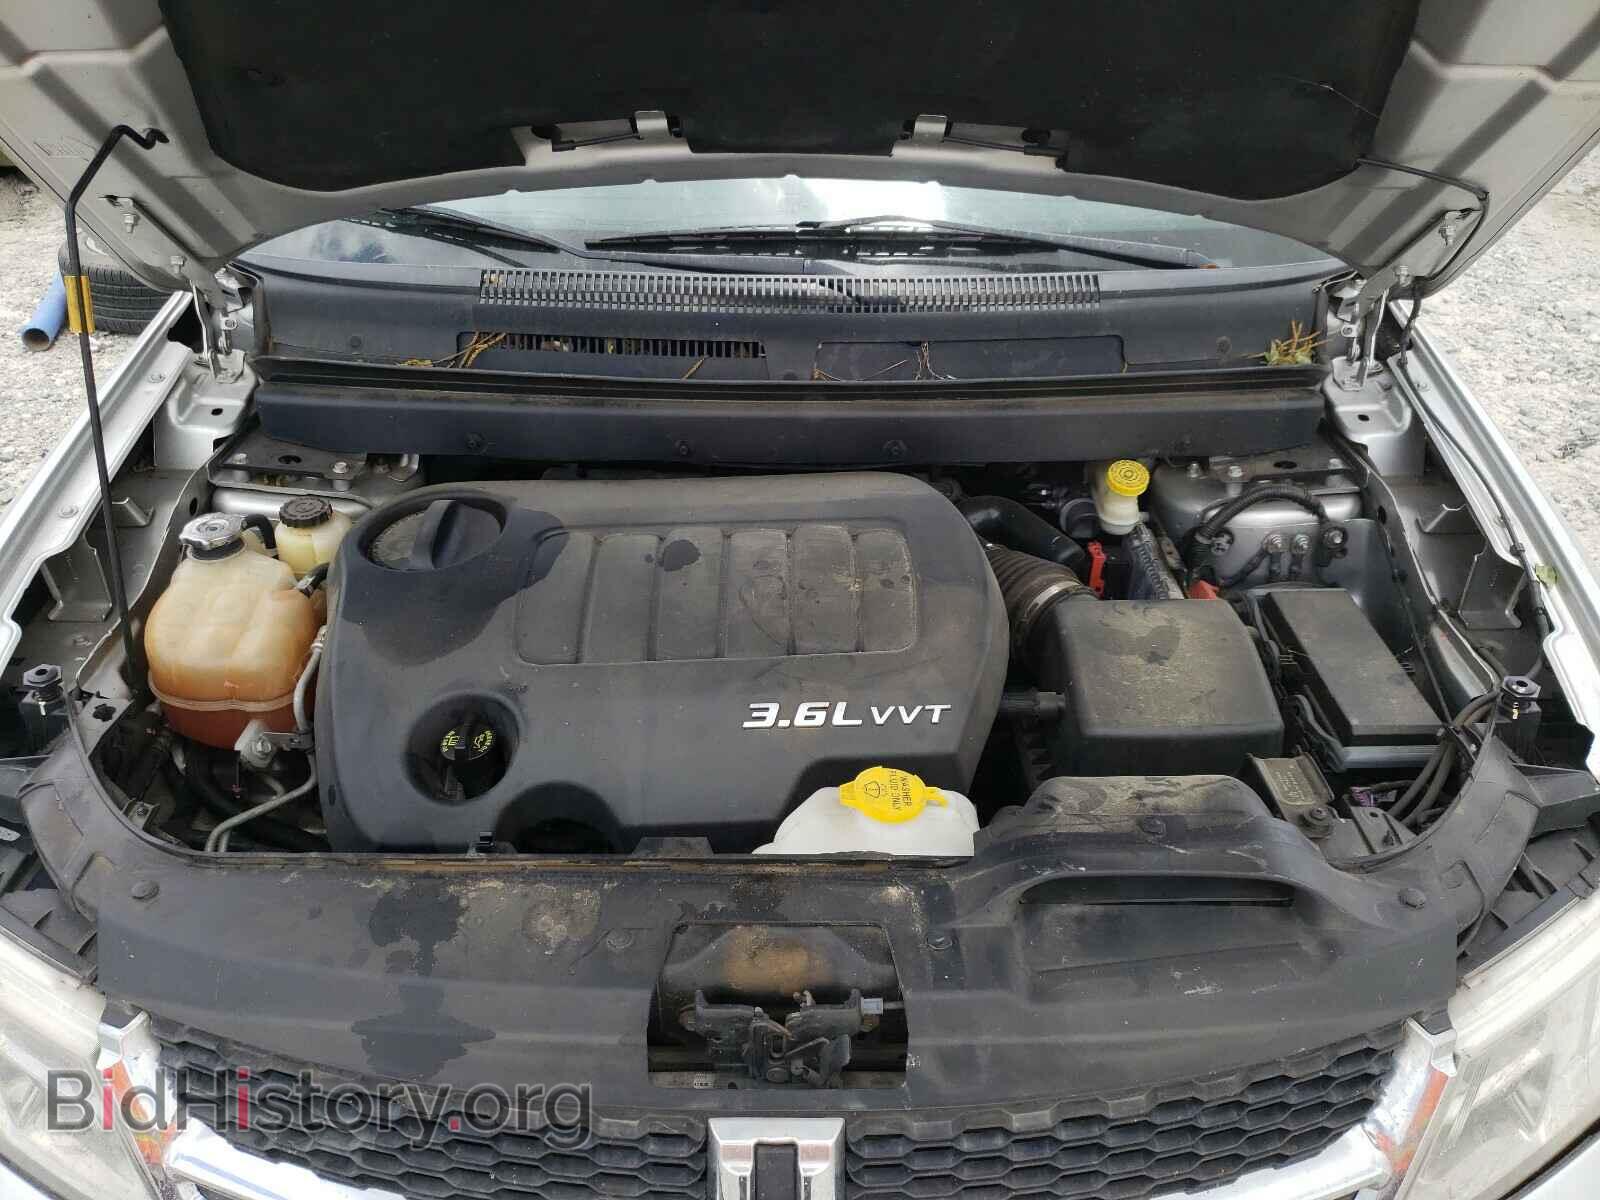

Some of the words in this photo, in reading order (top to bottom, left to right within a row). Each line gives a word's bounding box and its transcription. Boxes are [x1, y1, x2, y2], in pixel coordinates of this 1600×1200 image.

[743, 701, 862, 728] 3.6L
[870, 704, 951, 725] VVT
[899, 775, 913, 807] WASHER
